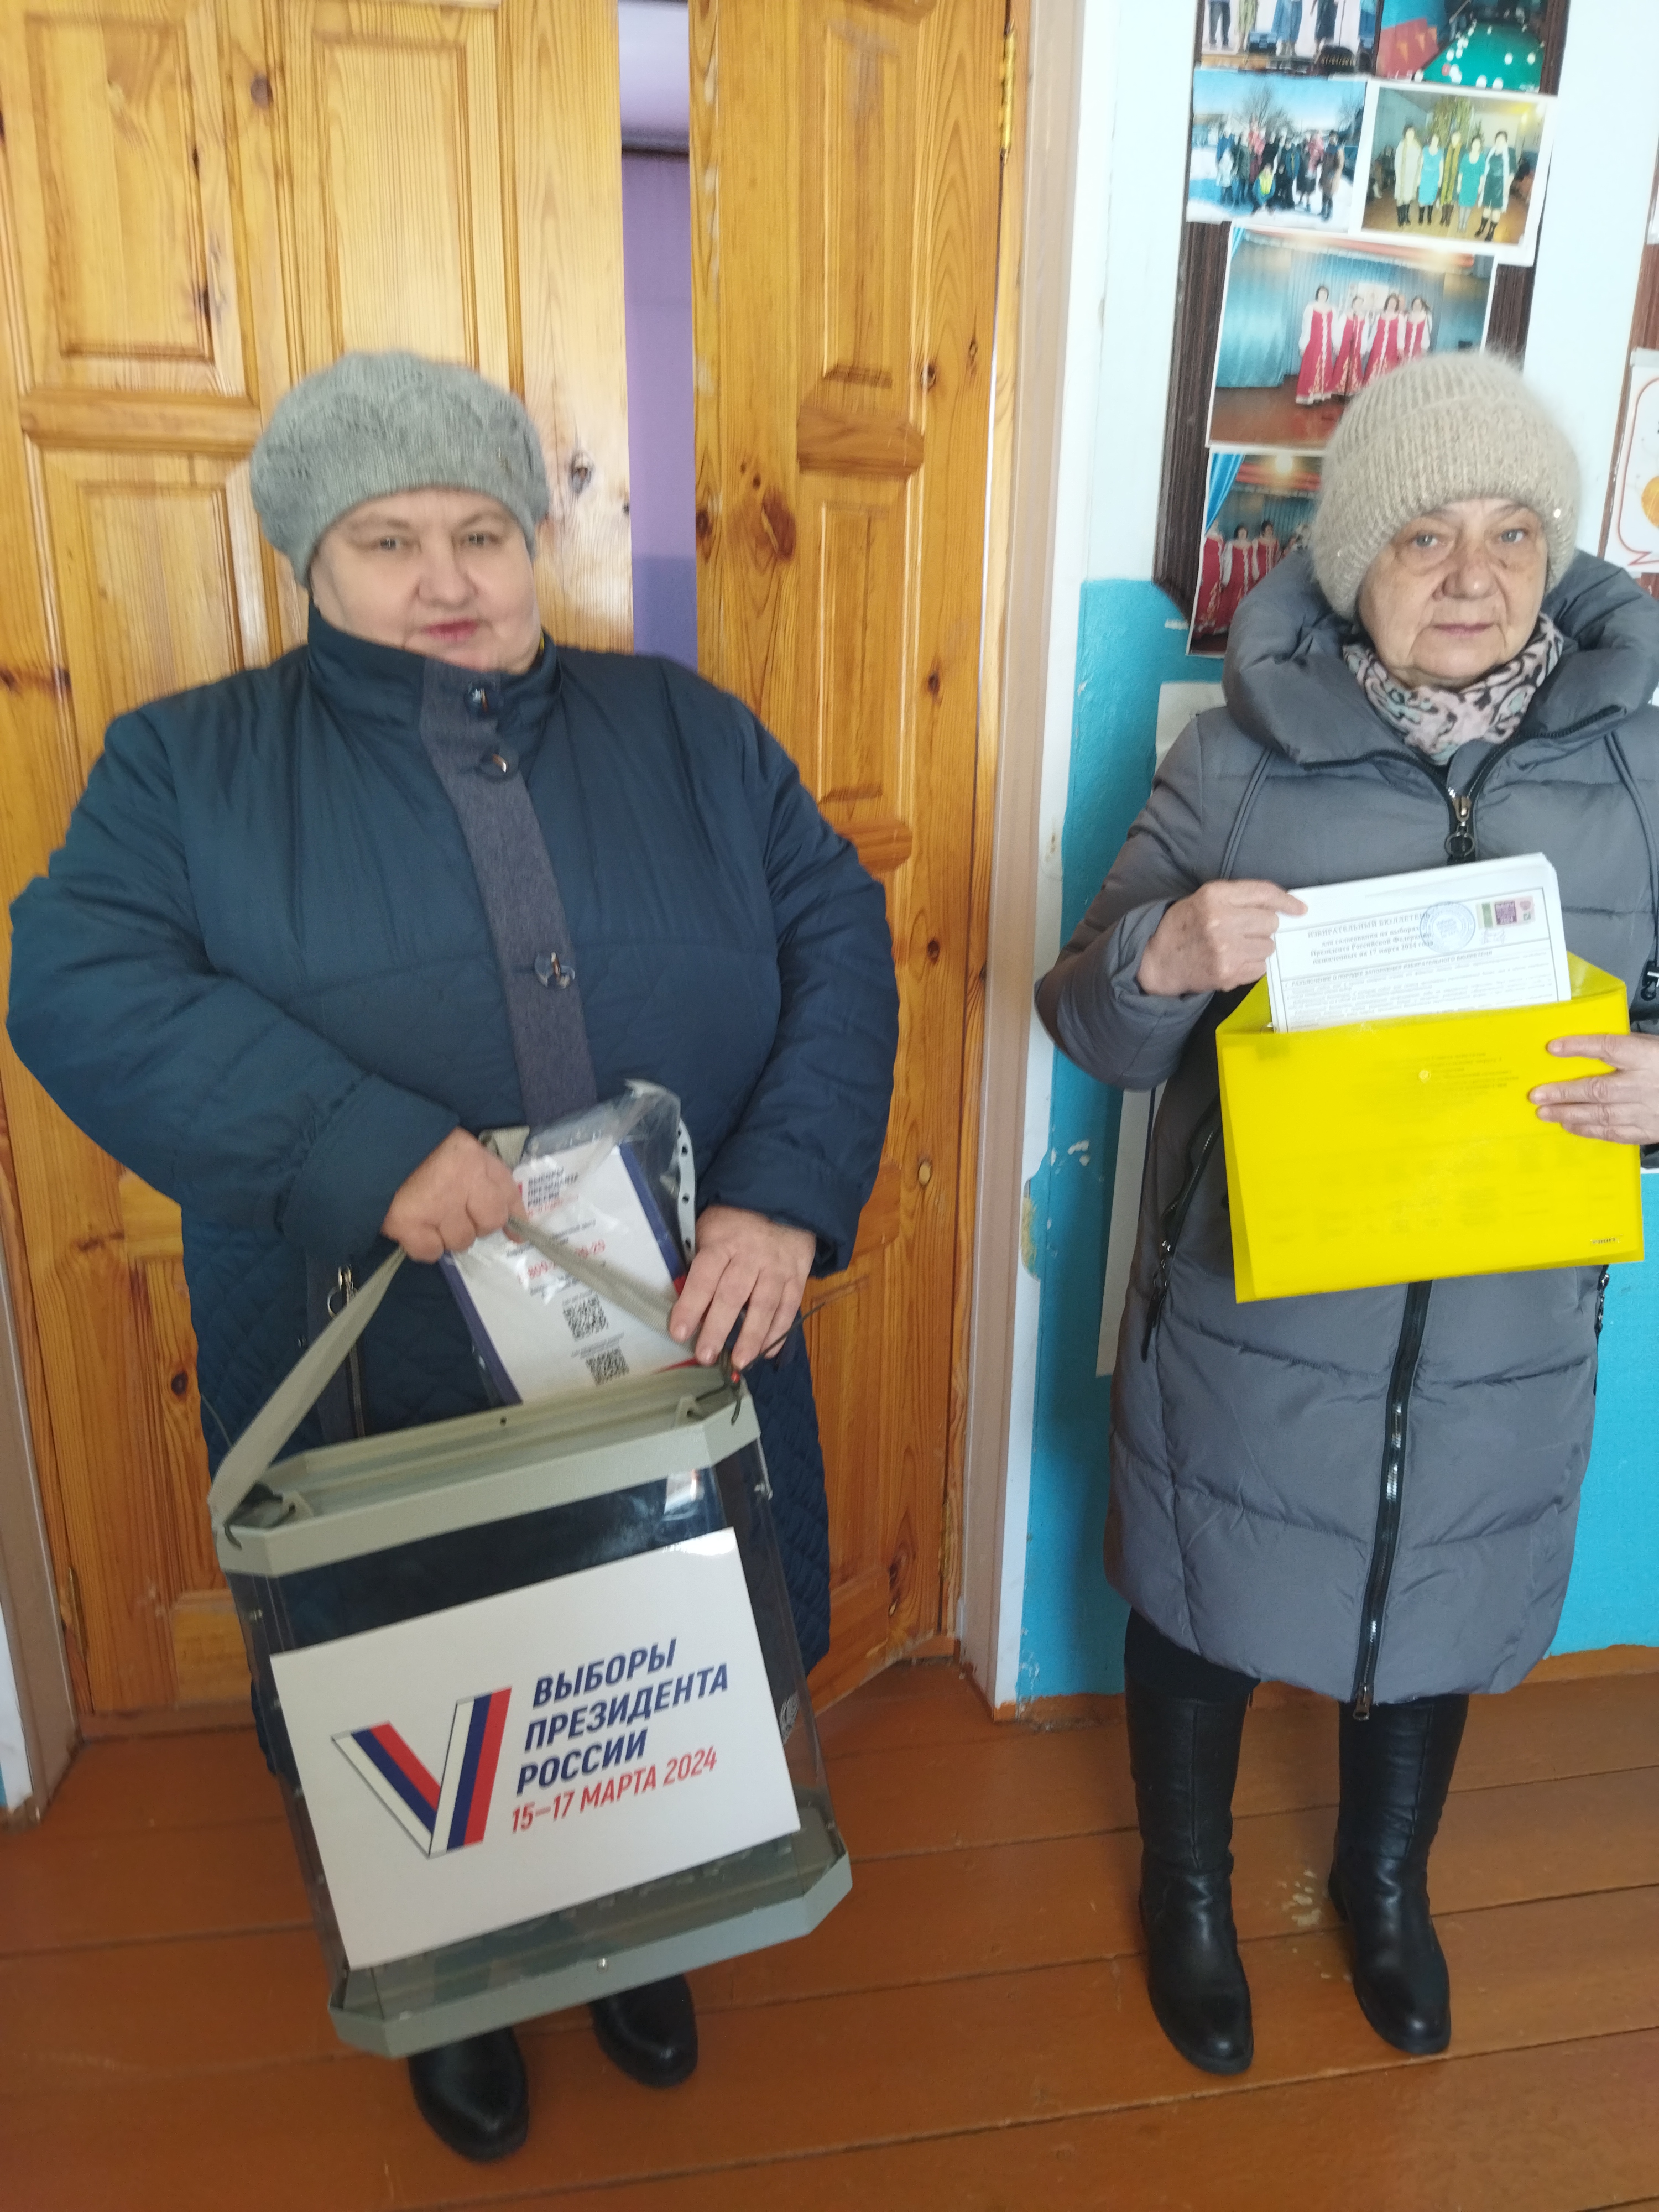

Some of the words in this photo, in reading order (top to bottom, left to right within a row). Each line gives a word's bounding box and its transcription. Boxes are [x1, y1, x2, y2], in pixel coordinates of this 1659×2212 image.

[1307, 920, 1377, 938] ИЗБИРАТЕЛЬНЫЙ
[1379, 912, 1430, 926] БЮЛЛЕТЕНЬ
[1401, 942, 1416, 950] 2024
[533, 1639, 676, 1707] ВЫБОРЫ
[525, 1664, 727, 1750] ПРЕЗИДЕНТА
[517, 1729, 648, 1793] РОССИИ
[580, 1765, 656, 1811] МАРТА
[662, 1746, 716, 1786] 2024
